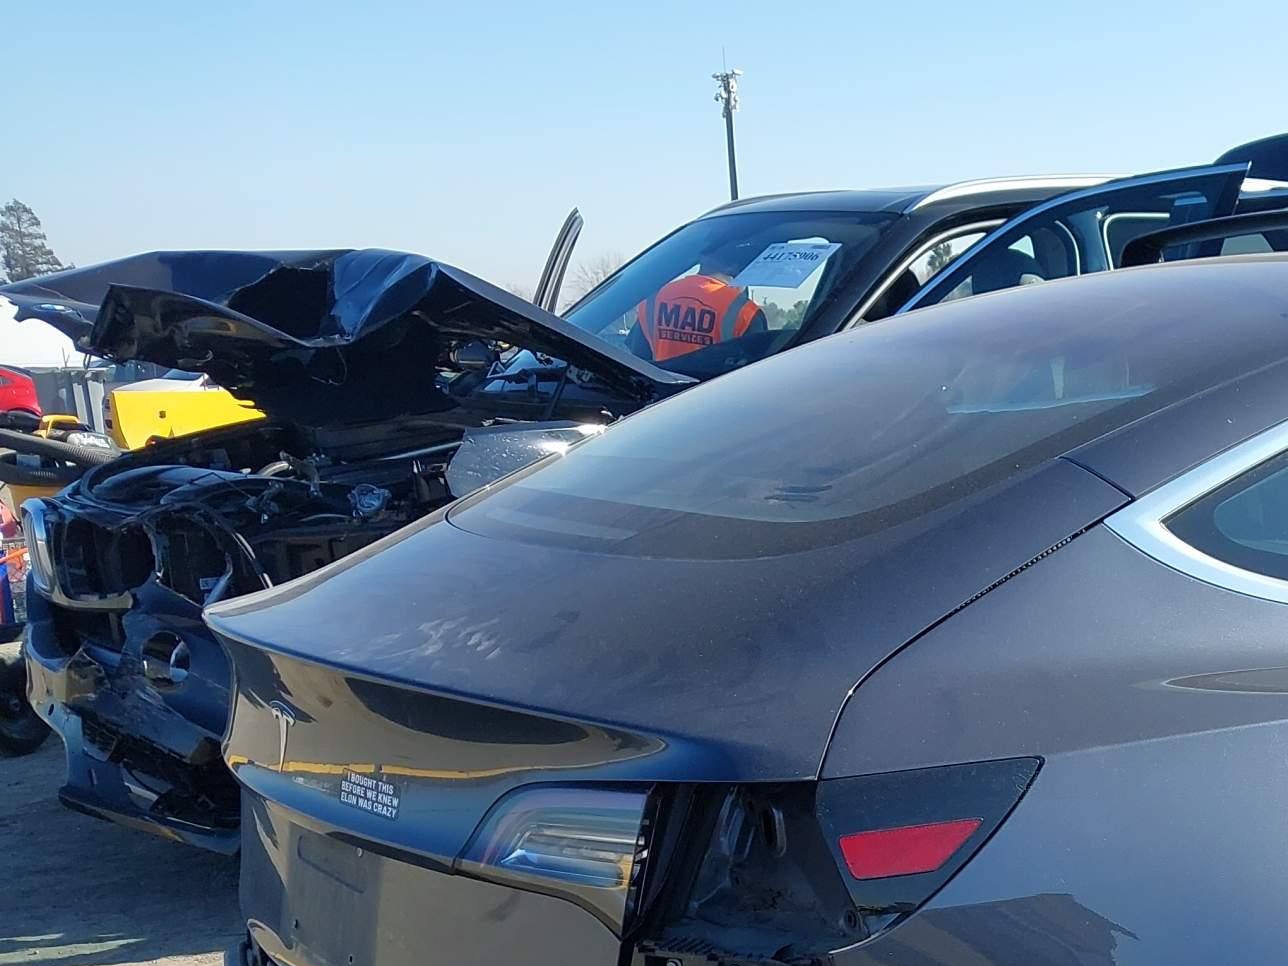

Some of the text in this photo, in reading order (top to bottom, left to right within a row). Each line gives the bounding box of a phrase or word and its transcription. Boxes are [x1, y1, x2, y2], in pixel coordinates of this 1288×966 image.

[657, 302, 716, 334] MAD
[658, 329, 714, 345] SERVICES
[341, 780, 399, 808] BEFORE WE KNEW
[350, 772, 377, 790] BOUGHT
[377, 781, 394, 796] THIS
[340, 791, 397, 818] ELON WAS CRAZY
